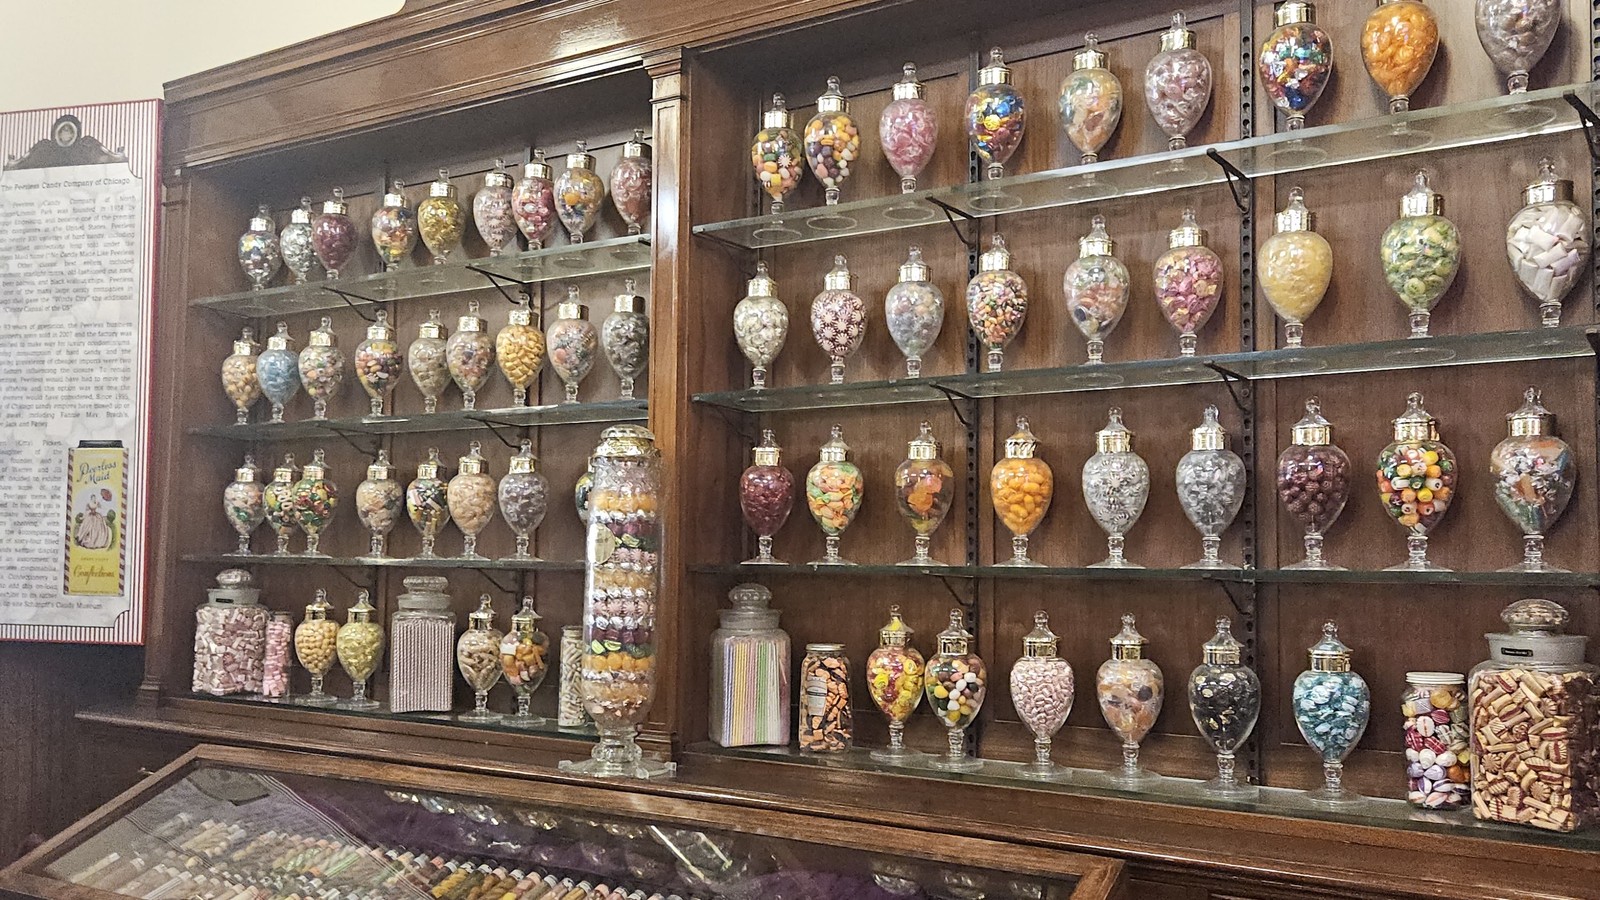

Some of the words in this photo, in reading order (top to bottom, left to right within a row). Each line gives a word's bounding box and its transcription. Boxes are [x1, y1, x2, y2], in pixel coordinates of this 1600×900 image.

[64, 180, 93, 188] Company
[103, 178, 130, 186] Chicago
[77, 459, 116, 482] Peerless
[84, 472, 110, 484] Maid
[74, 564, 114, 584] Confections
